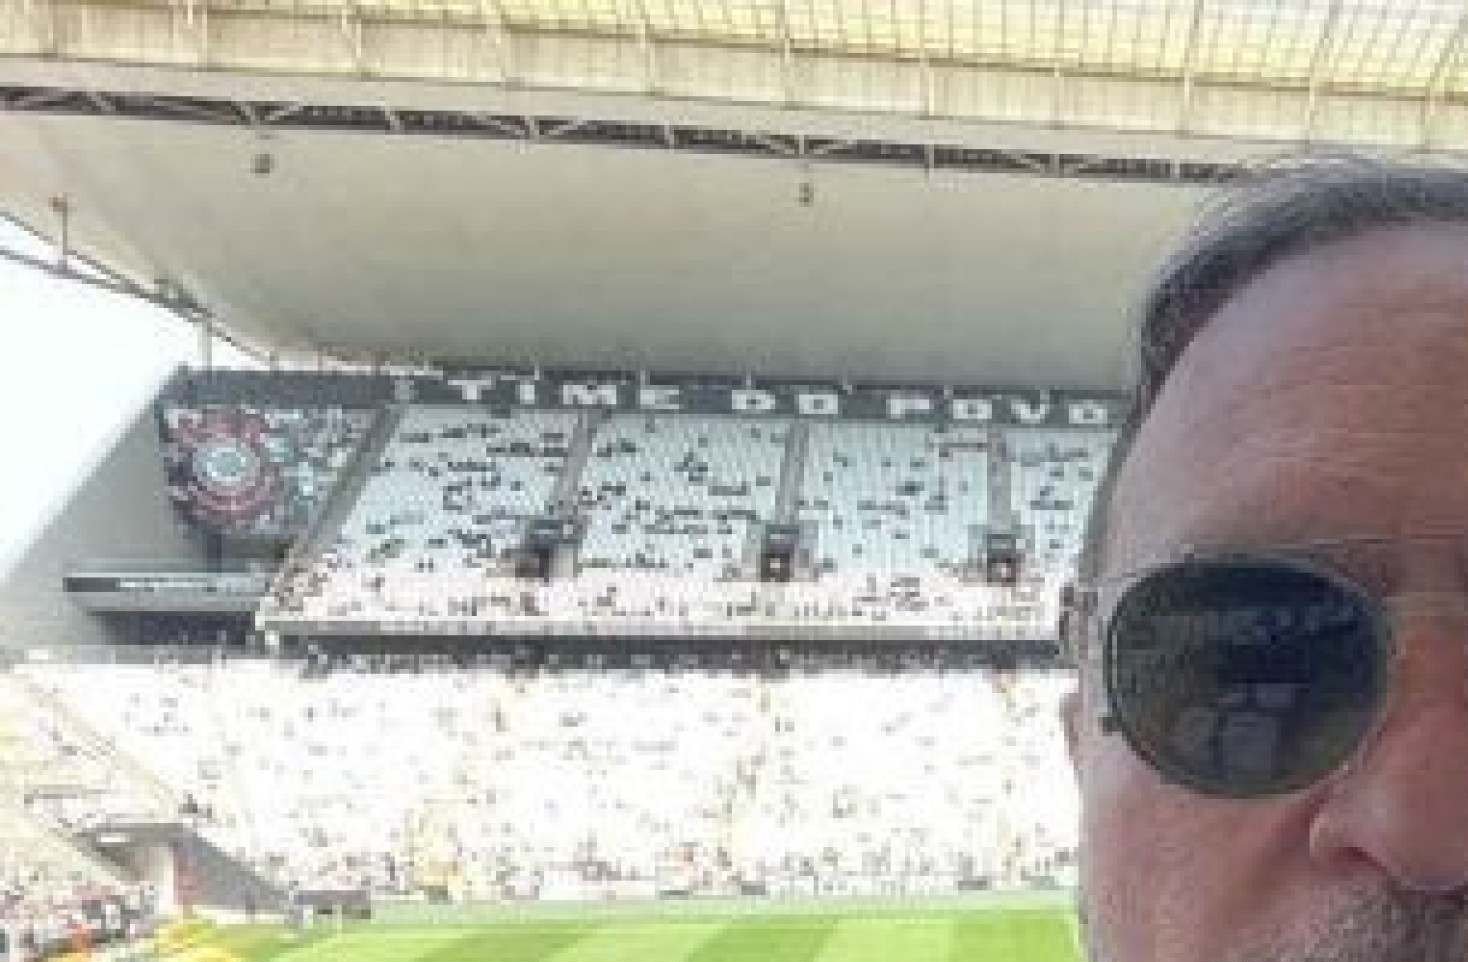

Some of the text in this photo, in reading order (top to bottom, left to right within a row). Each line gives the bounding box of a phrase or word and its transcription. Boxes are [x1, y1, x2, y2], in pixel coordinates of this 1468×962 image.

[447, 379, 681, 409] TIME
[730, 390, 840, 415] DO
[889, 397, 1109, 425] POVO
